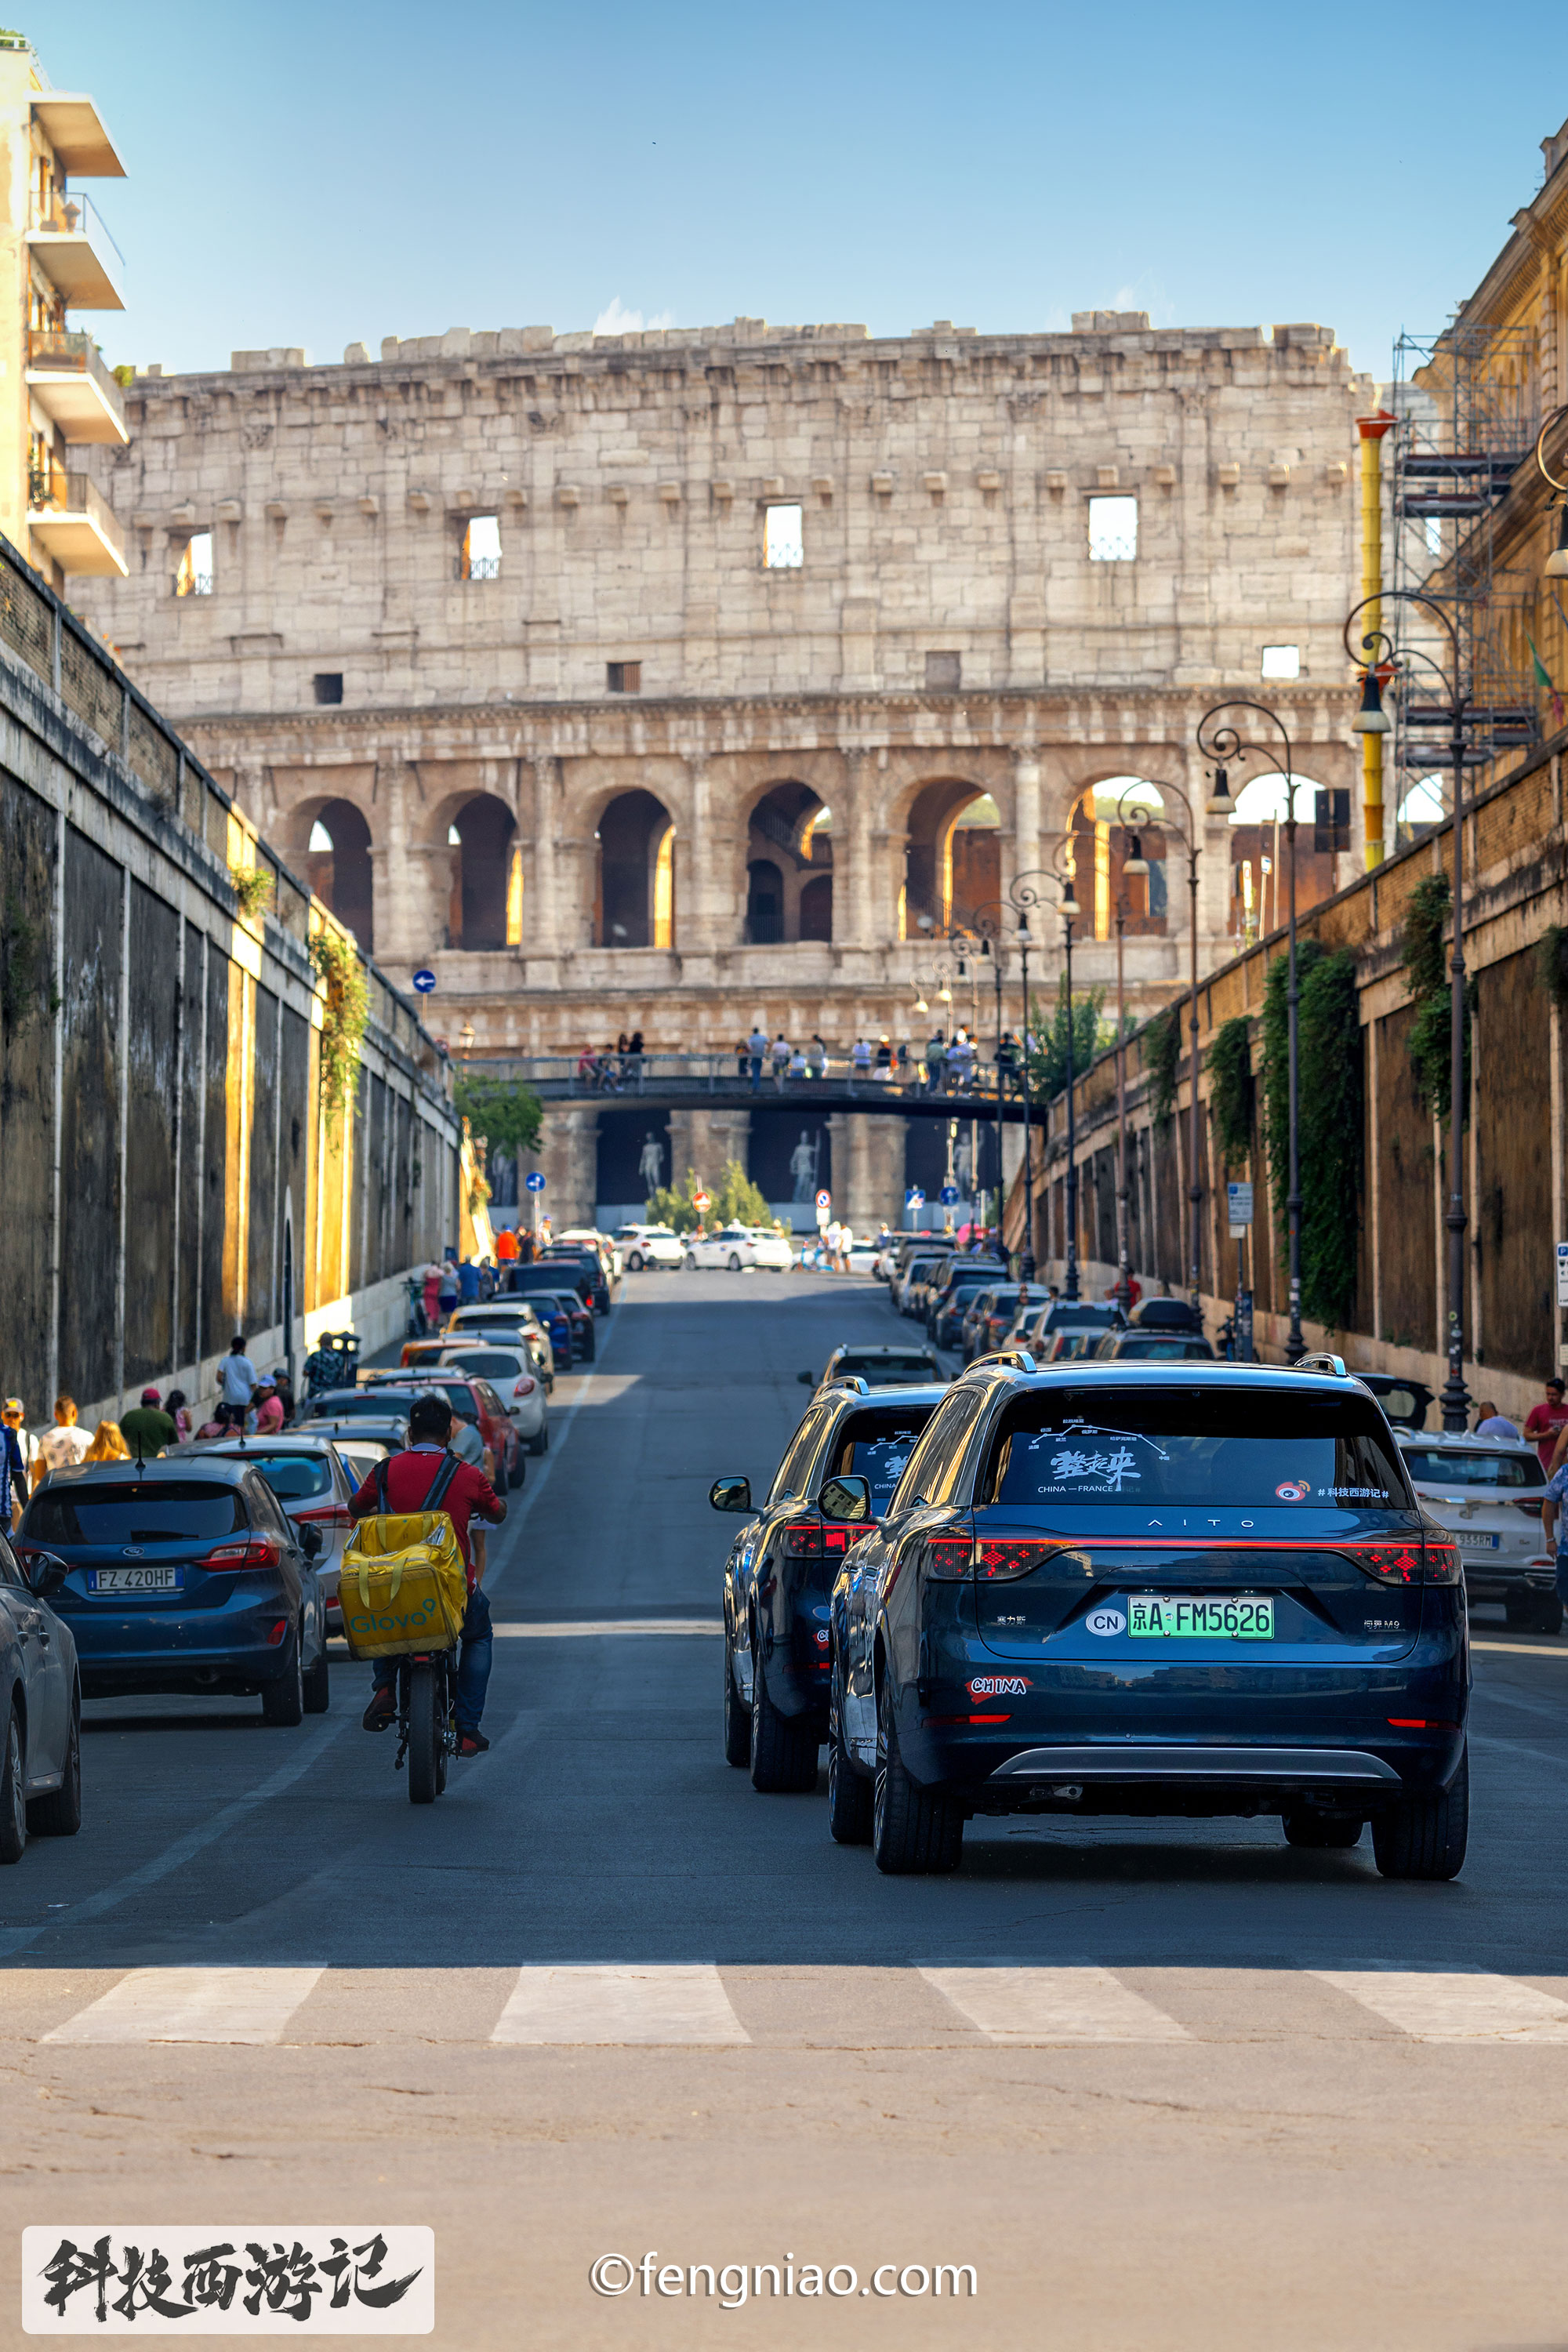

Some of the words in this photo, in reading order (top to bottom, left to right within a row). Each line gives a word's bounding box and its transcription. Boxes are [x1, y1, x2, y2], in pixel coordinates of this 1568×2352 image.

[1148, 1519, 1254, 1527] AITO
[350, 1611, 427, 1633] Glovo
[1093, 1616, 1119, 1629] CN
[971, 1678, 1026, 1694] CHINA
